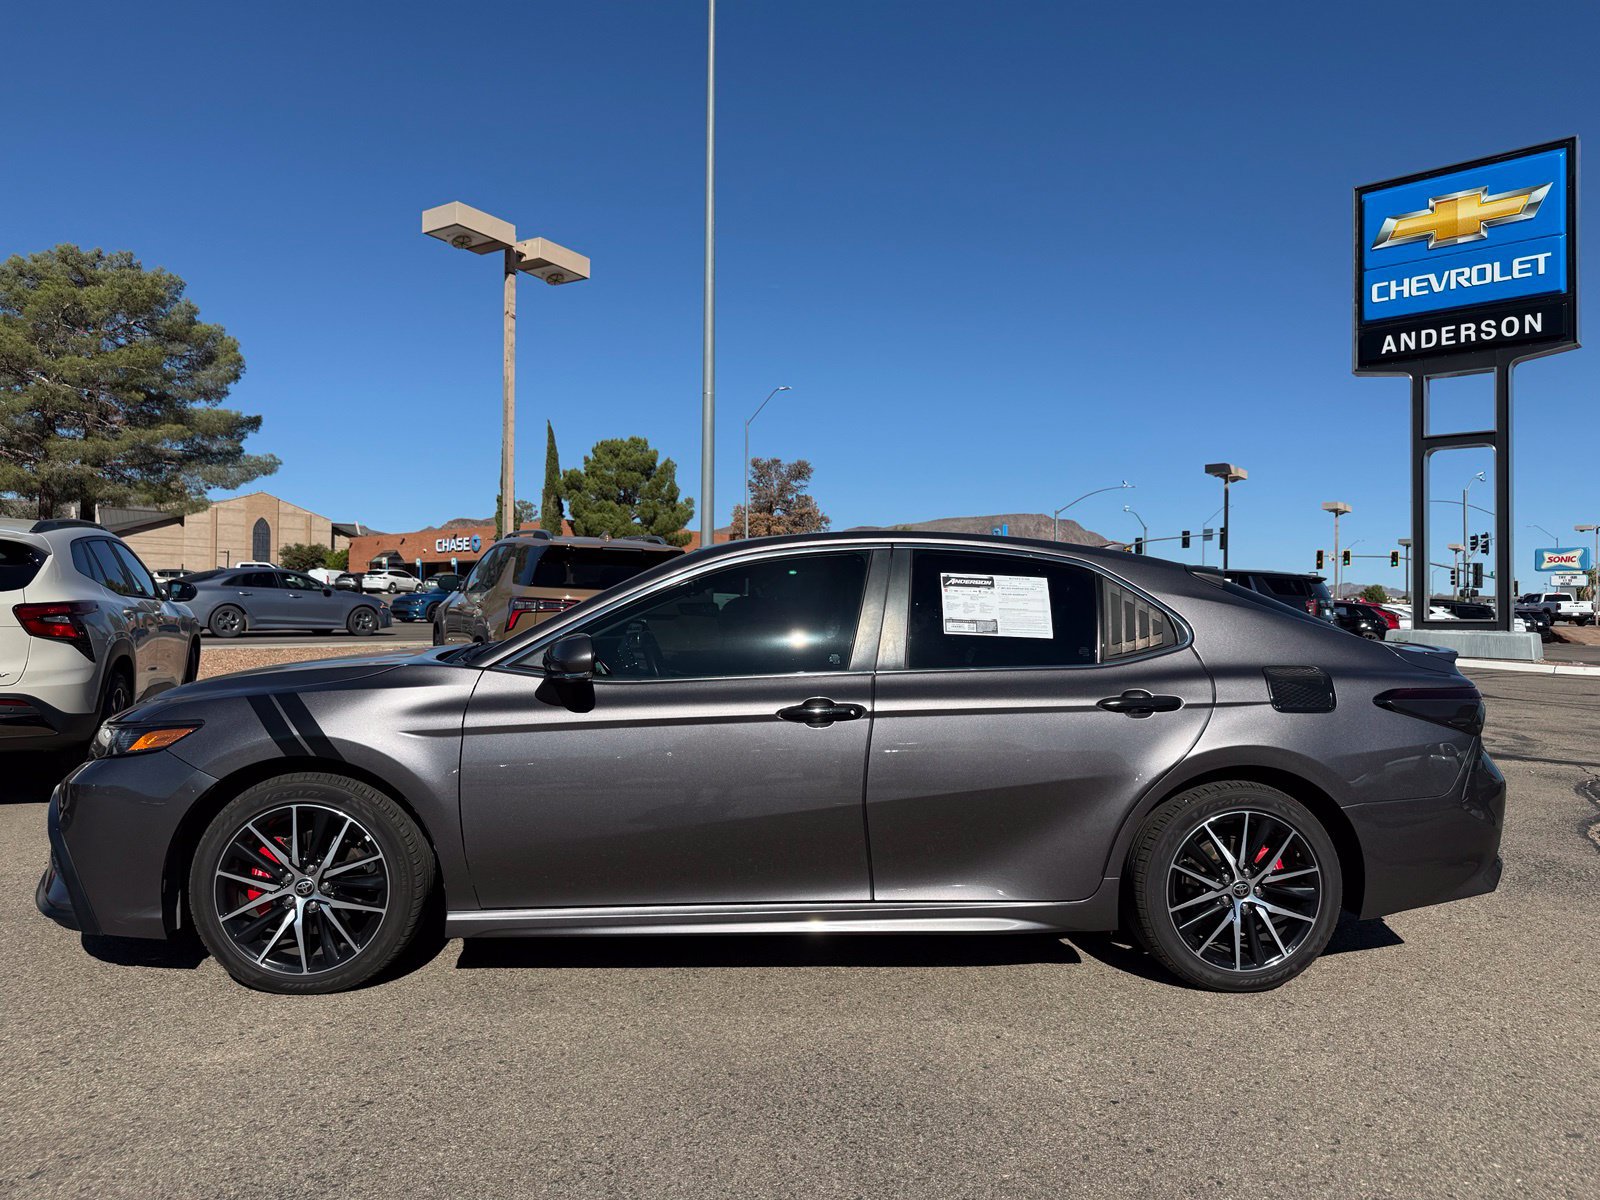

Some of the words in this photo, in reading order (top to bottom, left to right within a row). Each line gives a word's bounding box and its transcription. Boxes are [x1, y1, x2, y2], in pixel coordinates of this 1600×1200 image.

[1371, 251, 1552, 303] CHEVROLET
[1381, 312, 1542, 355] ANDERSON
[436, 537, 471, 553] CHASE
[945, 578, 992, 586] ANDERSON
